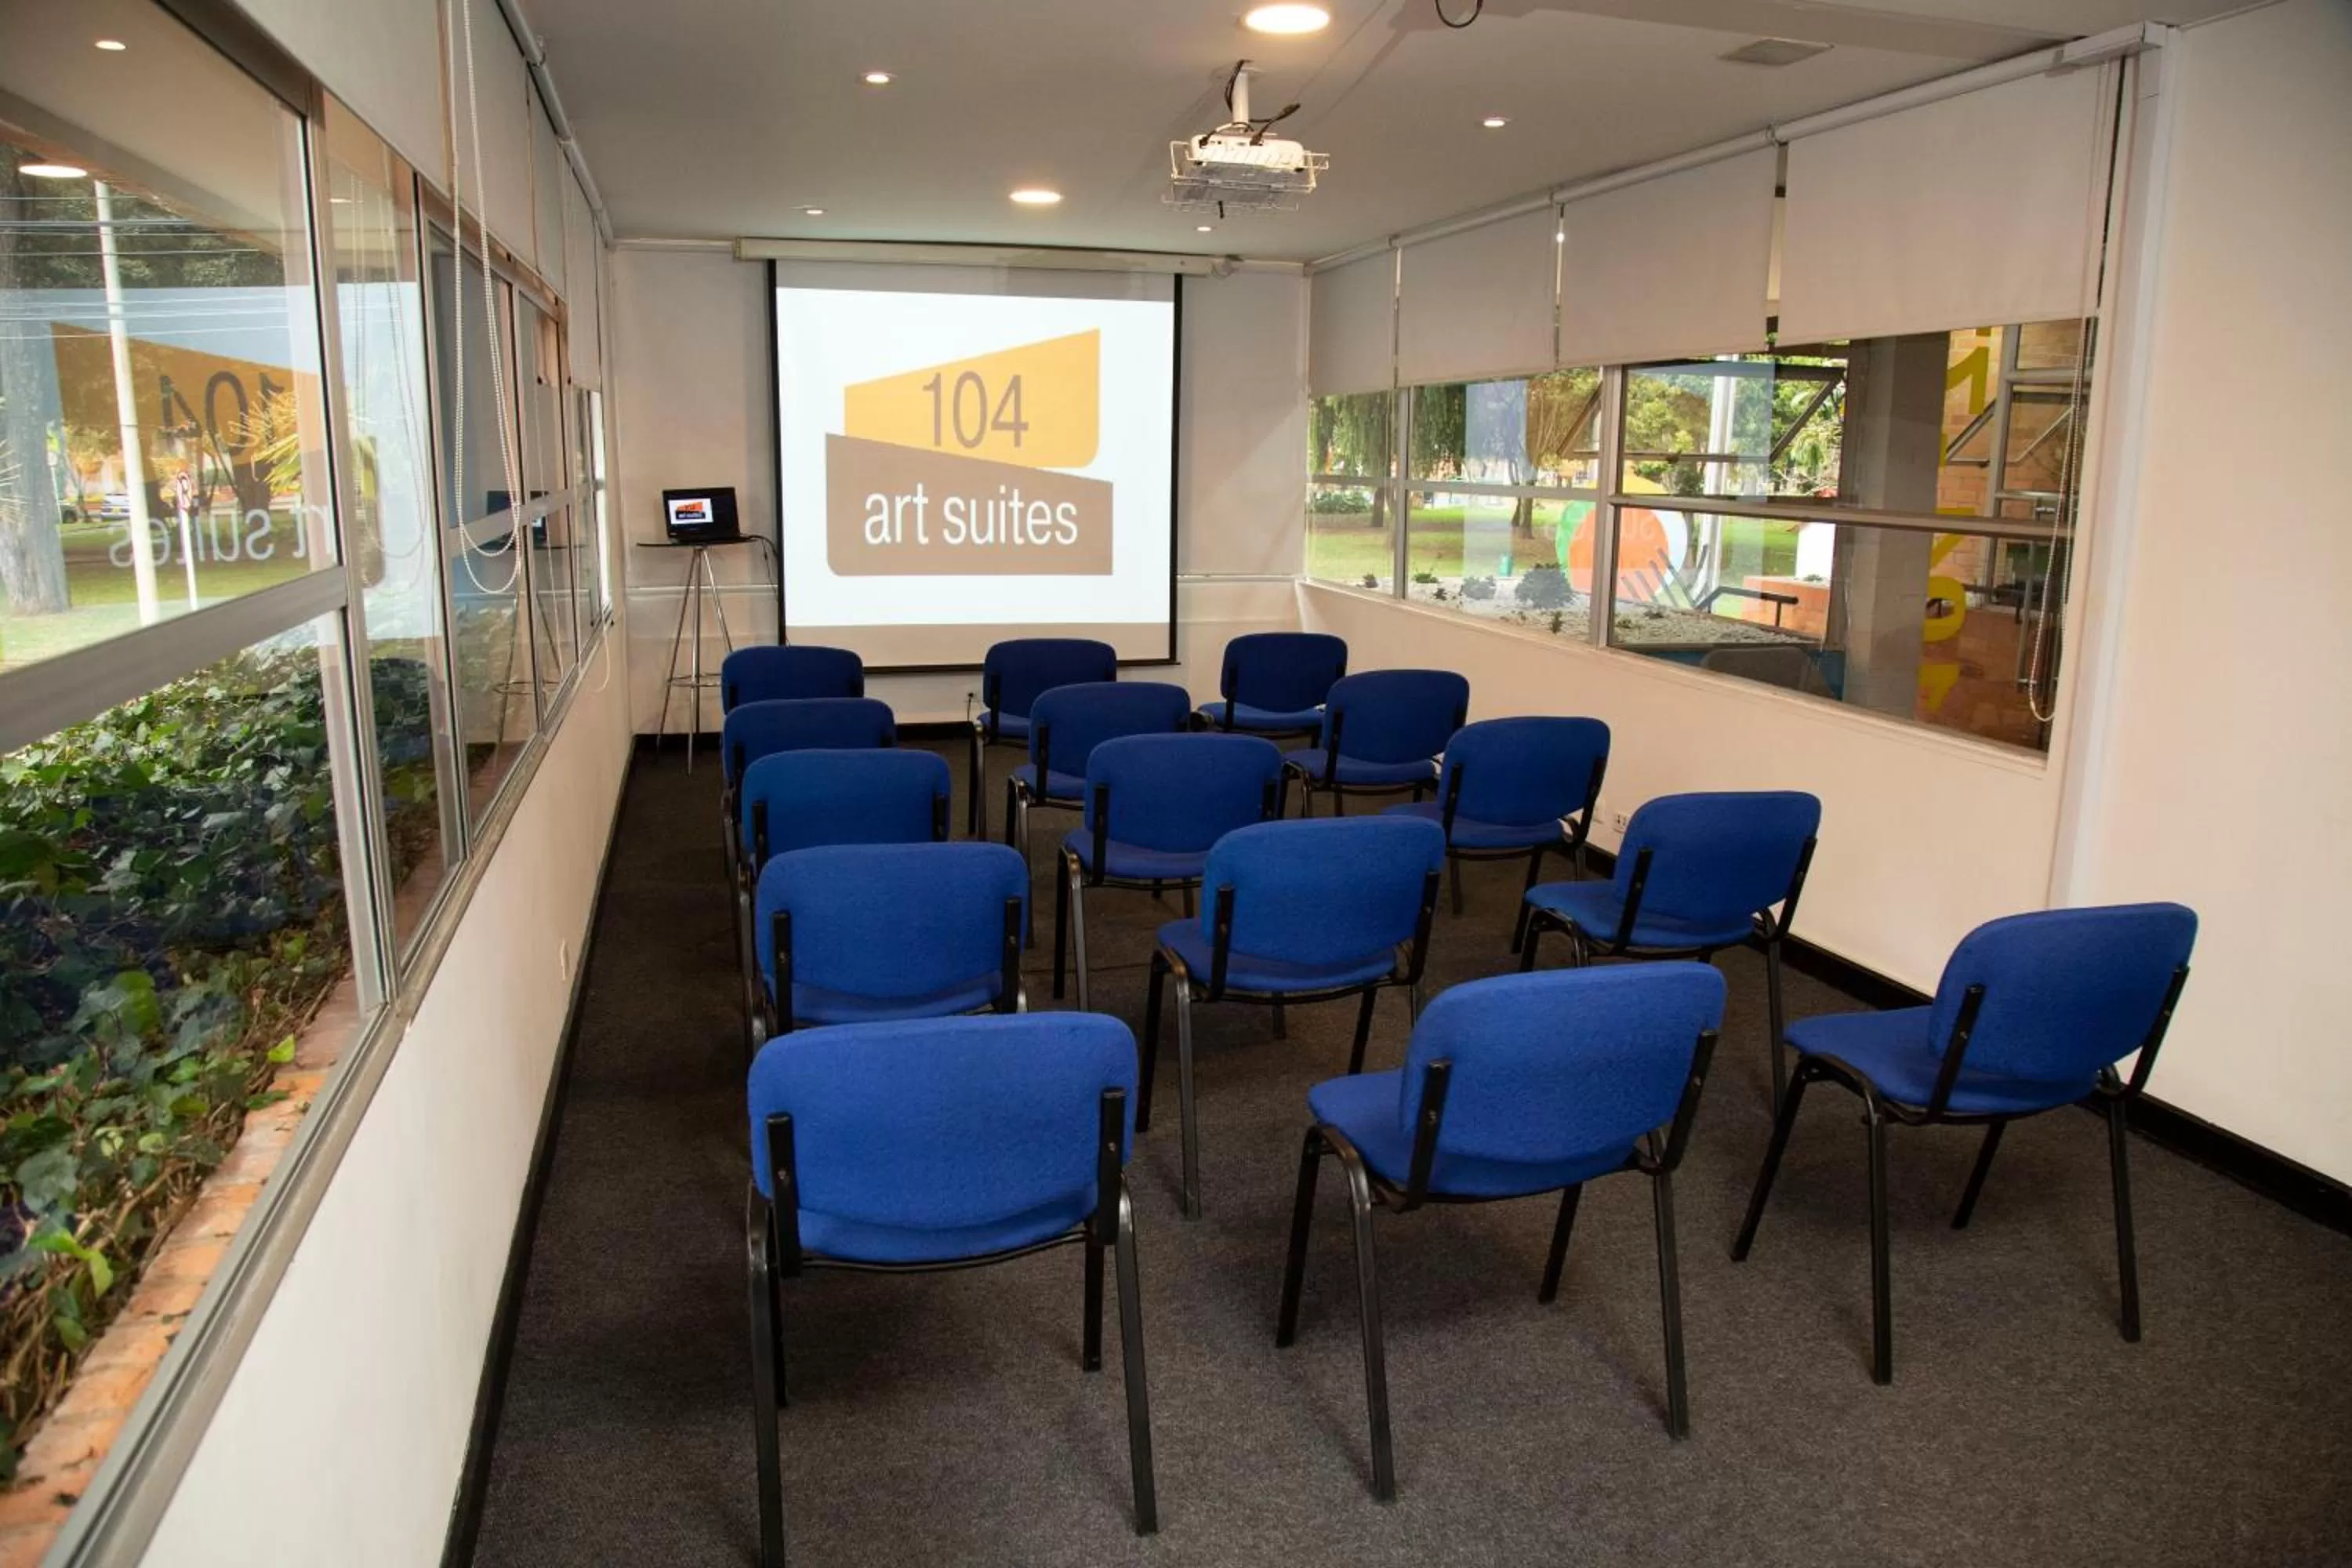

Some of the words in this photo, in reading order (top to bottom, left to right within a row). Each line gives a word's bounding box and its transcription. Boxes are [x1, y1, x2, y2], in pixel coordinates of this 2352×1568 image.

[923, 371, 1029, 449] 104
[865, 483, 929, 546] art
[942, 485, 1079, 546] suites
